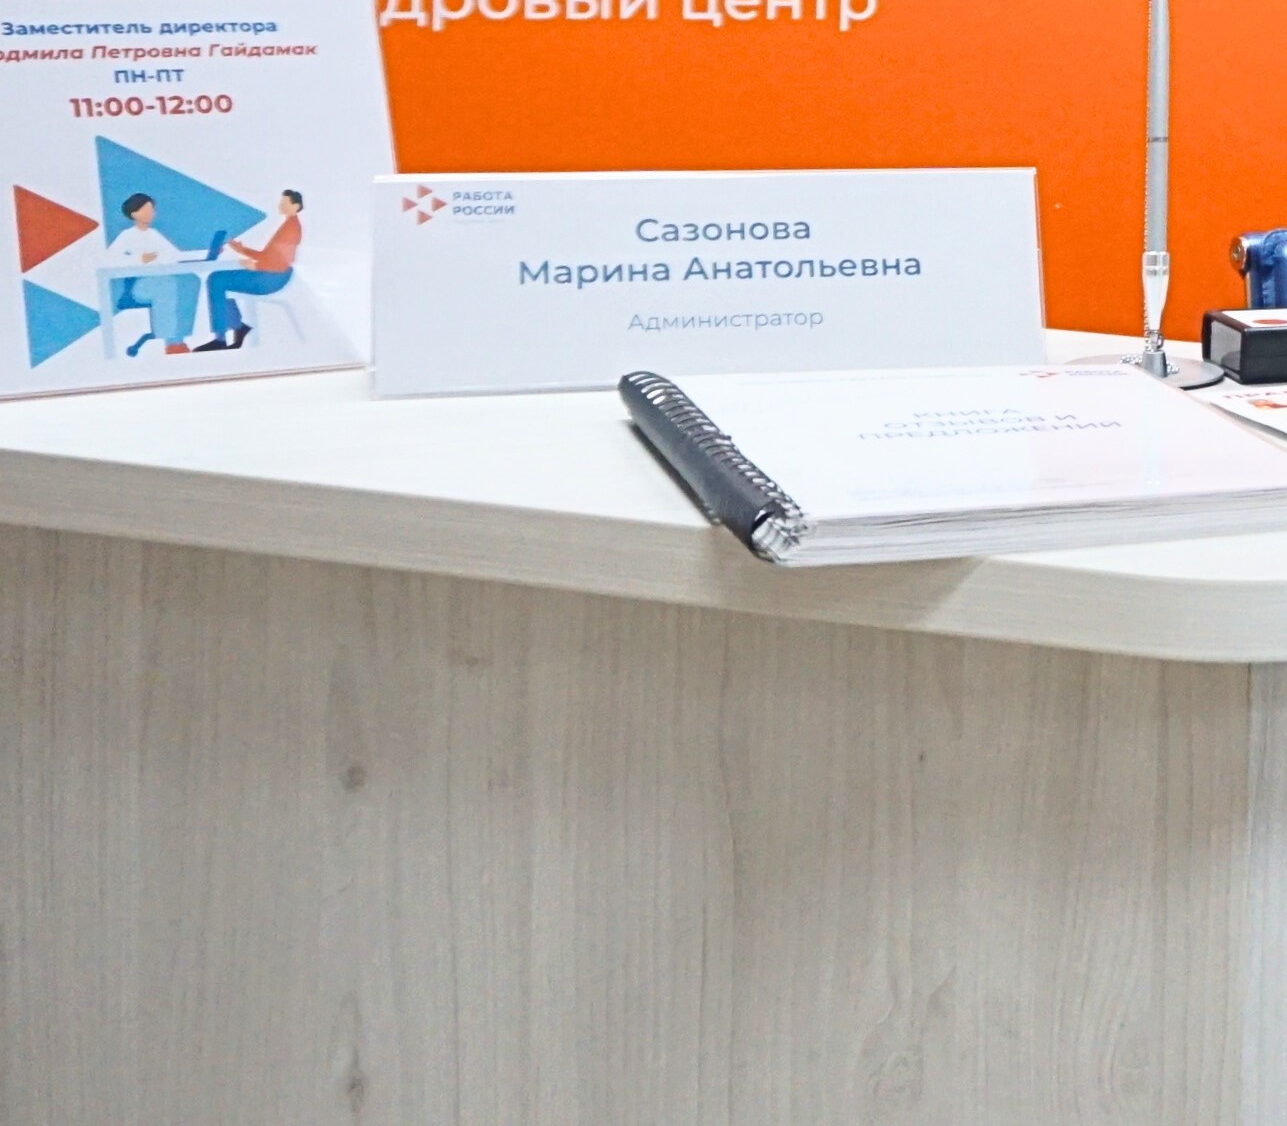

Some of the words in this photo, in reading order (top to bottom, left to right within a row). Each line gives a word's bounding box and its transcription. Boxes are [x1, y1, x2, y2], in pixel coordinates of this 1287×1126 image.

[2, 22, 152, 36] Заместитель
[159, 21, 279, 36] директора
[91, 45, 201, 62] Петровна
[209, 43, 319, 59] Гайдамак
[113, 68, 185, 83] ПН-ПТ
[69, 94, 233, 118] 11:00-12:00
[452, 190, 514, 201] РАБОТА
[452, 204, 516, 216] РОССИИ
[635, 218, 811, 242] Сазонова
[518, 258, 671, 289] Марина
[683, 252, 923, 281] Анатольевна
[627, 309, 824, 332] Администратор
